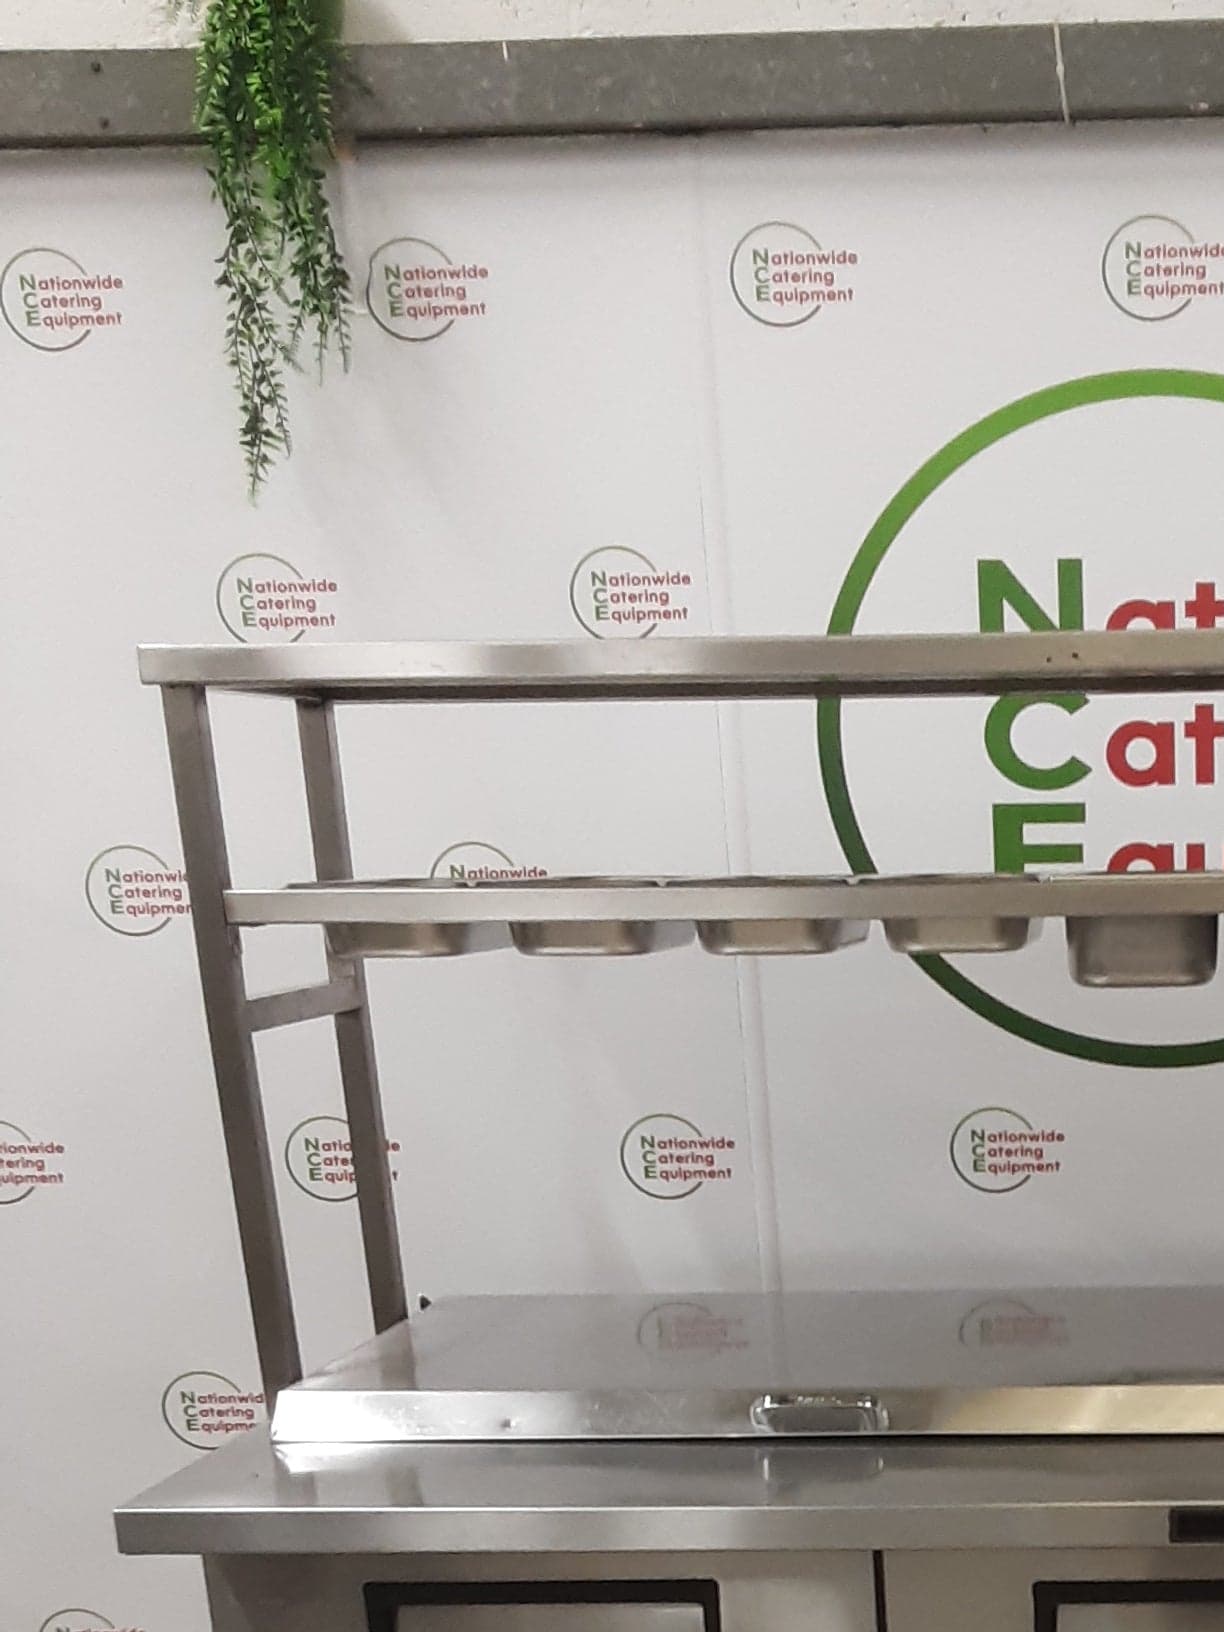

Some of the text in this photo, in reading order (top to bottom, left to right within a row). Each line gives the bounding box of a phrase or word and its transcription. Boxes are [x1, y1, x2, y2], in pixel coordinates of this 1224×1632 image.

[752, 248, 858, 266] Nationwide
[385, 264, 489, 283] Nationwide
[754, 267, 835, 286] Catering
[1126, 260, 1207, 279] Catering
[19, 274, 123, 291] Nationwide
[386, 282, 467, 300] Catering
[1127, 279, 1224, 299] Equipment
[23, 293, 102, 310] Catering
[755, 285, 853, 304] Equipment
[26, 311, 122, 329] Equipment
[388, 301, 486, 321] Equipment
[237, 577, 338, 595] Nationwide
[590, 571, 692, 588] Nationwide
[239, 595, 316, 613] Catering
[592, 588, 669, 605] Catering
[241, 611, 336, 630] Equipment
[594, 605, 688, 624] Equipment
[449, 864, 548, 879] Nationwide
[108, 884, 182, 902] Catering
[640, 1135, 735, 1150] Nationwide
[970, 1129, 1065, 1143] Nationwide
[641, 1151, 715, 1166] Catering
[971, 1145, 1044, 1160] Catering
[644, 1166, 731, 1182] Equipment
[972, 1160, 1060, 1176] Equipment
[182, 1405, 255, 1419] Catering
